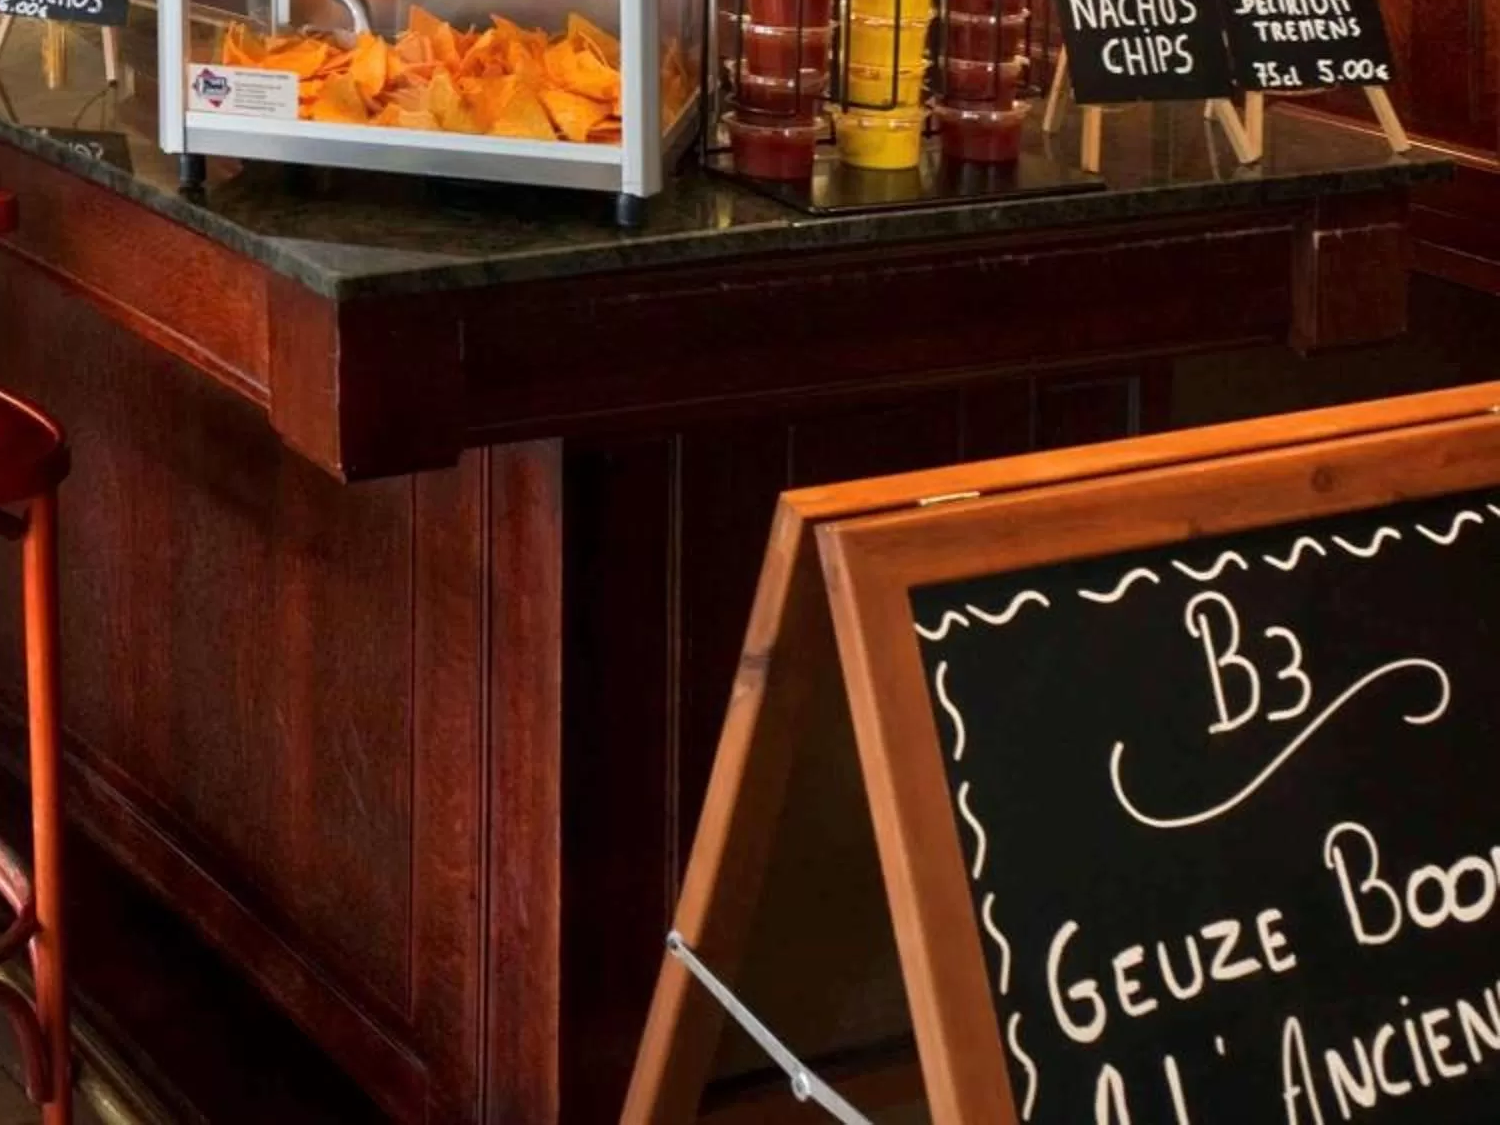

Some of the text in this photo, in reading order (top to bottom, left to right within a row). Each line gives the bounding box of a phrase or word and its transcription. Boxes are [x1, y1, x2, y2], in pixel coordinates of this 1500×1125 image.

[1252, 16, 1362, 43] TREMENS
[1316, 58, 1391, 84] 5.00€
[1184, 590, 1313, 735] B3
[1046, 821, 1500, 1043] GEUZE BOO
[1281, 980, 1500, 1125] ANCIEN
